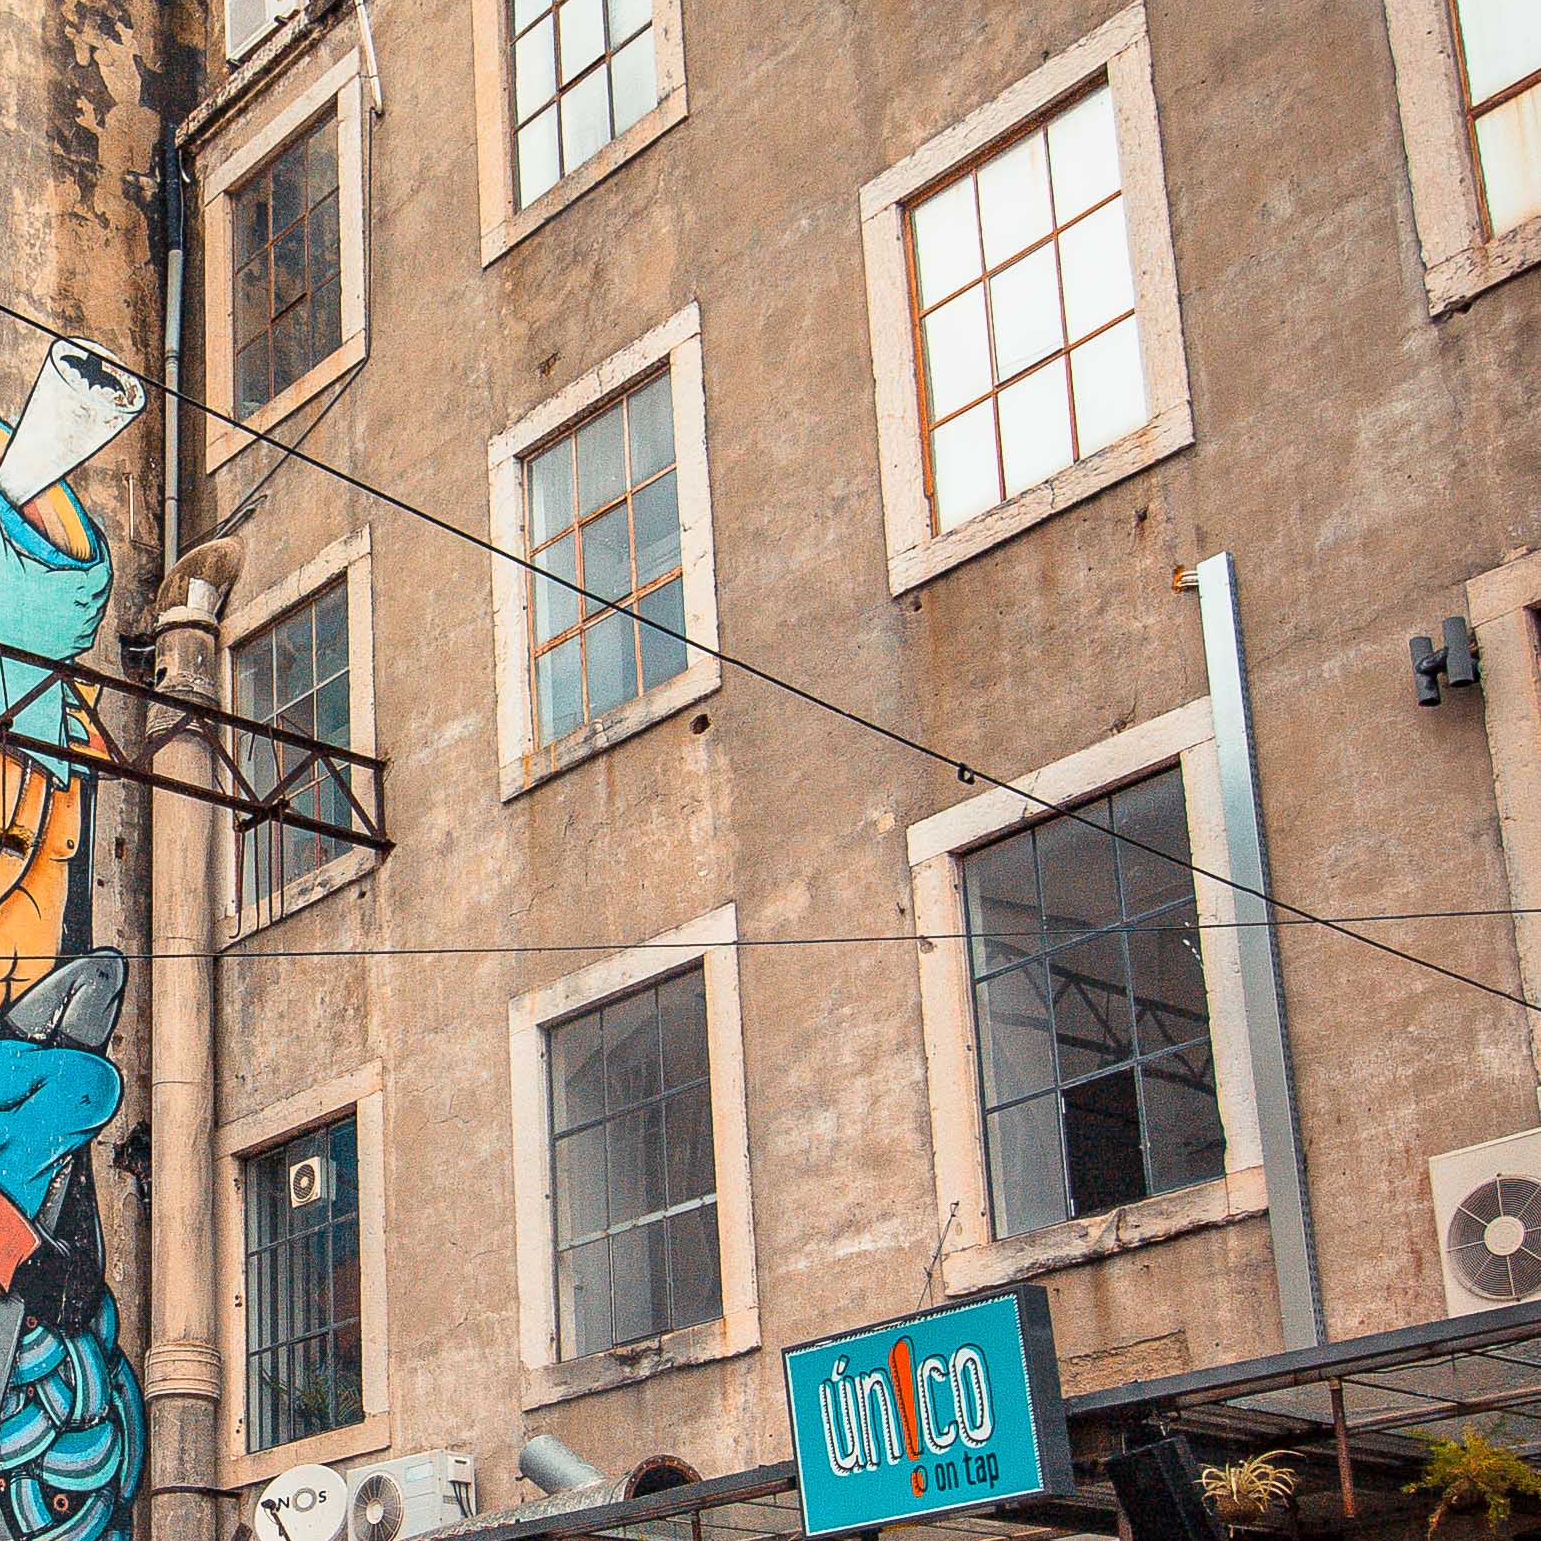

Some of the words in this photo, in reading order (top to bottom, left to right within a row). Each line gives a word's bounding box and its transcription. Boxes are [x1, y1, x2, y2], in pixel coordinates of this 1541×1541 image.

[934, 1460, 959, 1492] on
[962, 1451, 1000, 1489] tap
[276, 1487, 327, 1513] NOS
